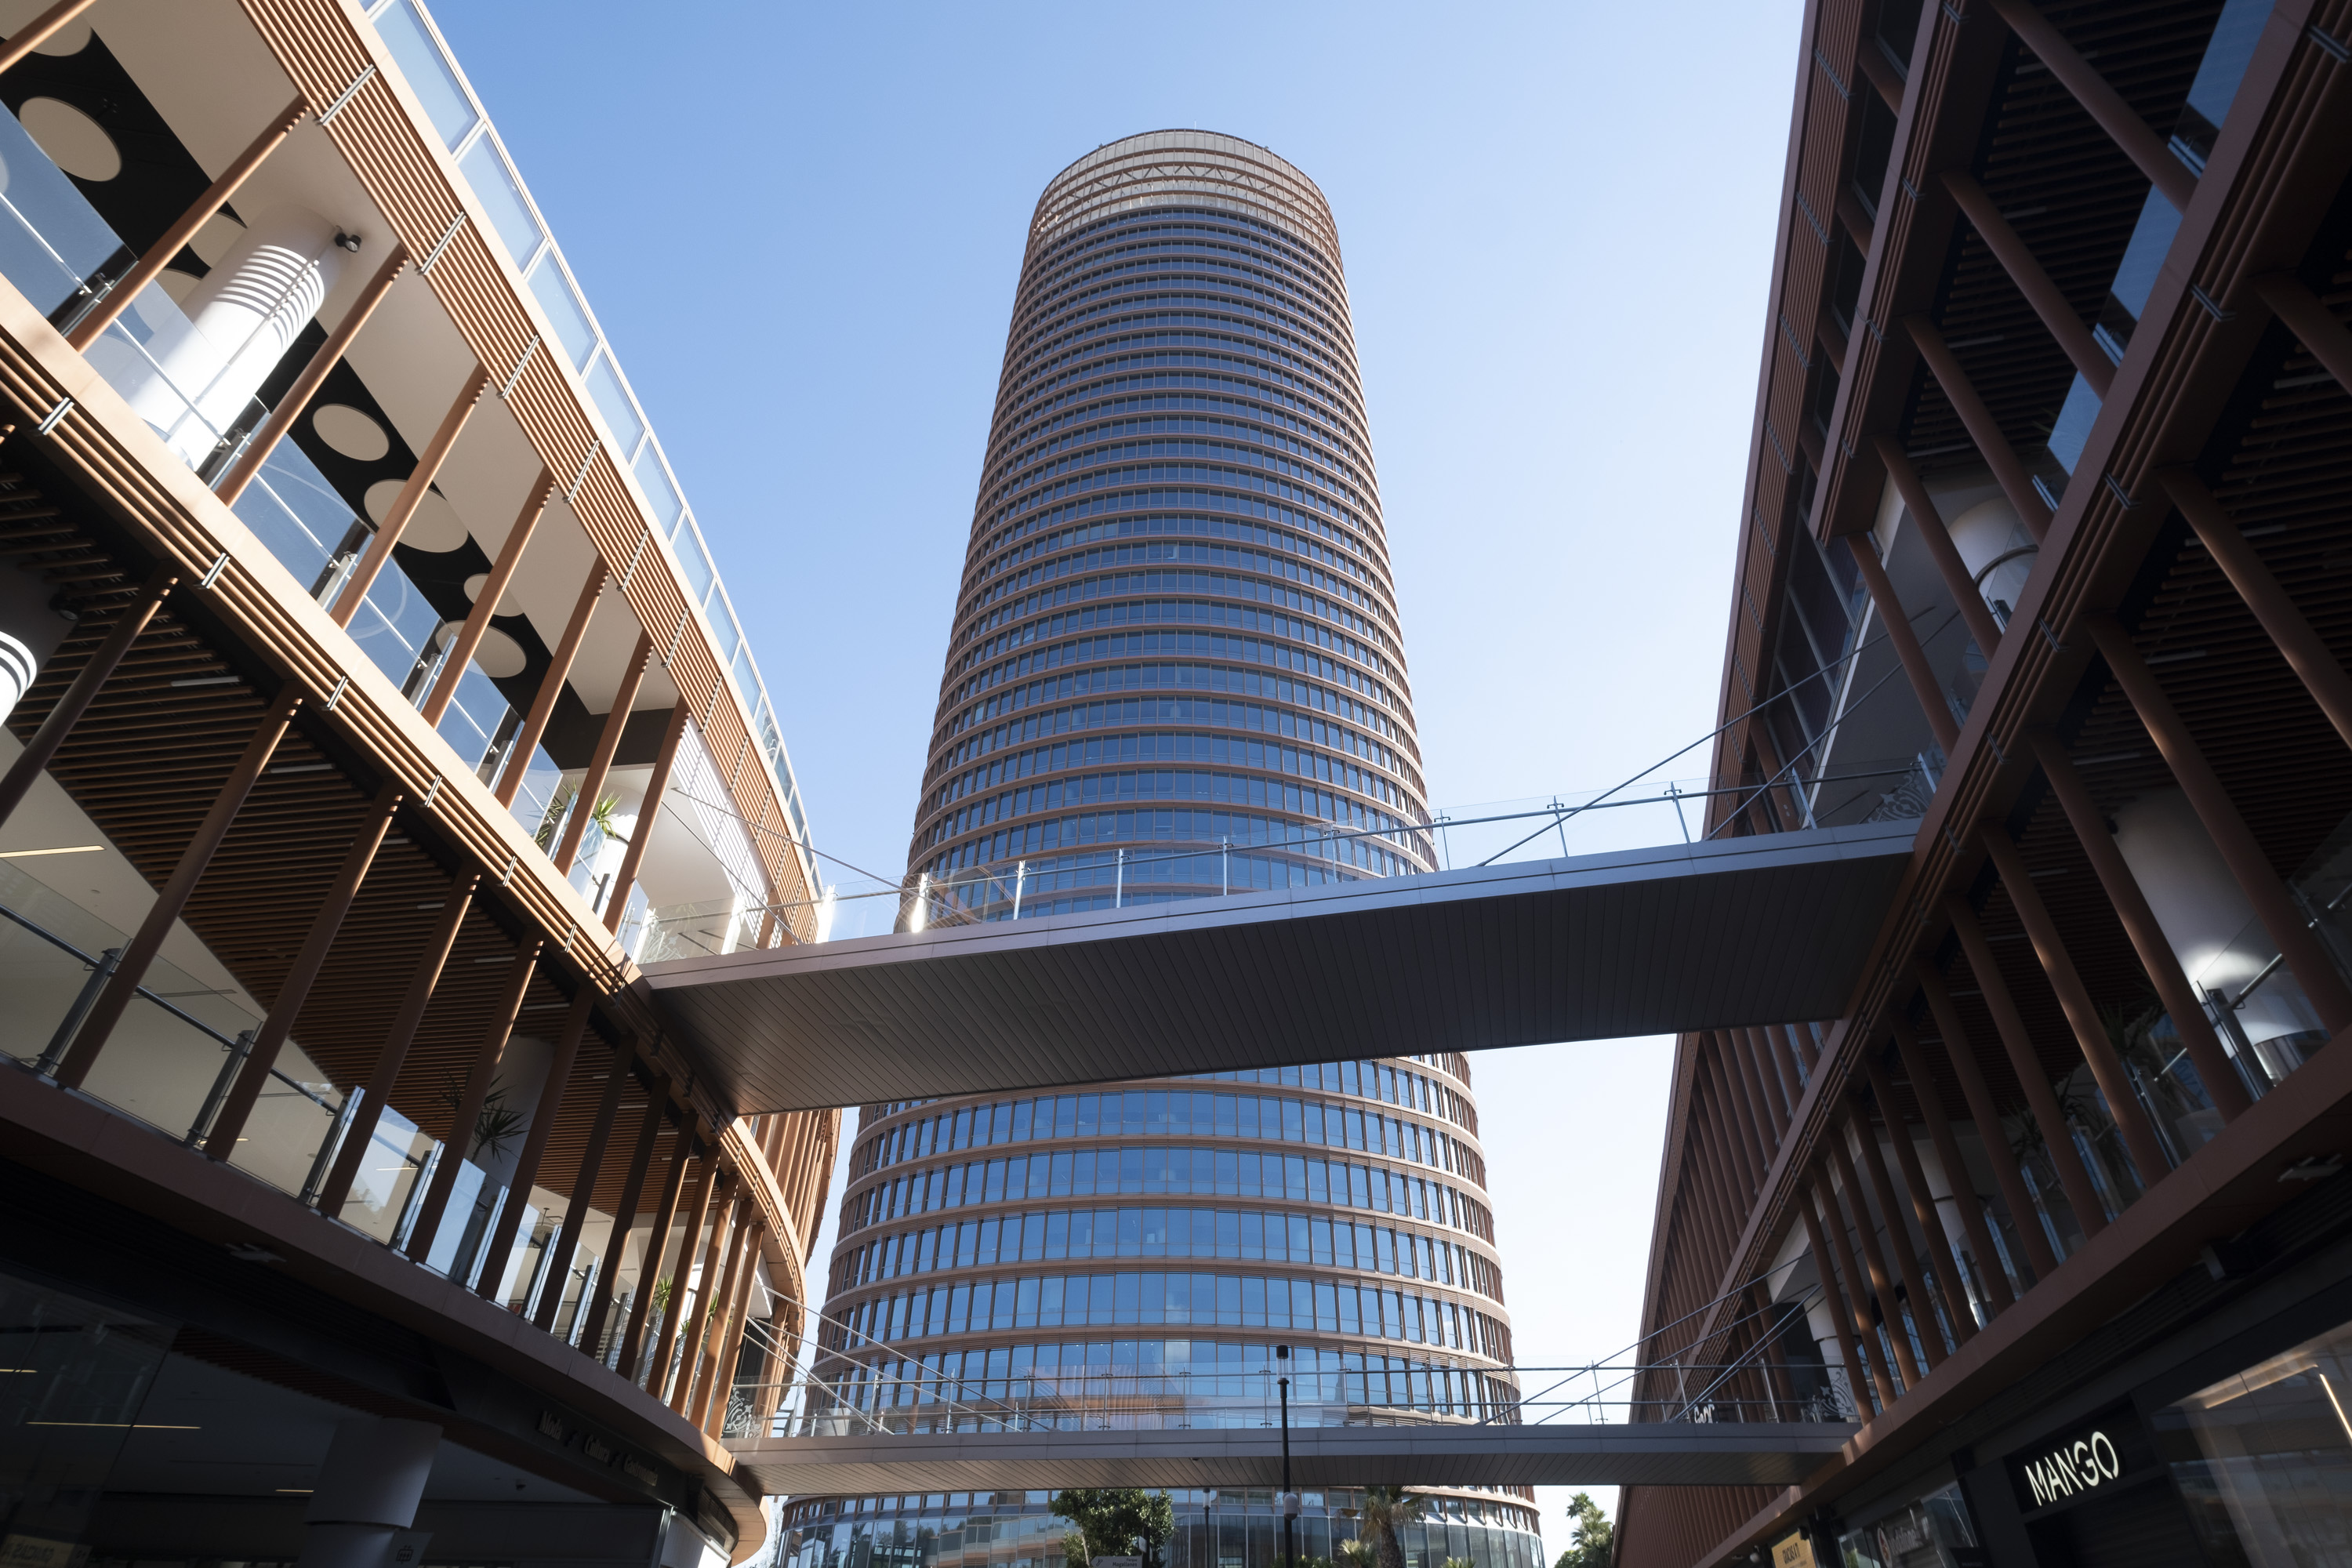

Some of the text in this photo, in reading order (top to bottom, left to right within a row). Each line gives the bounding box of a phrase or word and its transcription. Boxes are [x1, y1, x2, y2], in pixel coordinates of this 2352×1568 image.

[539, 1410, 563, 1441] Moda
[583, 1434, 610, 1464] Cultura
[2024, 1431, 2119, 1507] MANGO
[1888, 1526, 1923, 1556] vodafone
